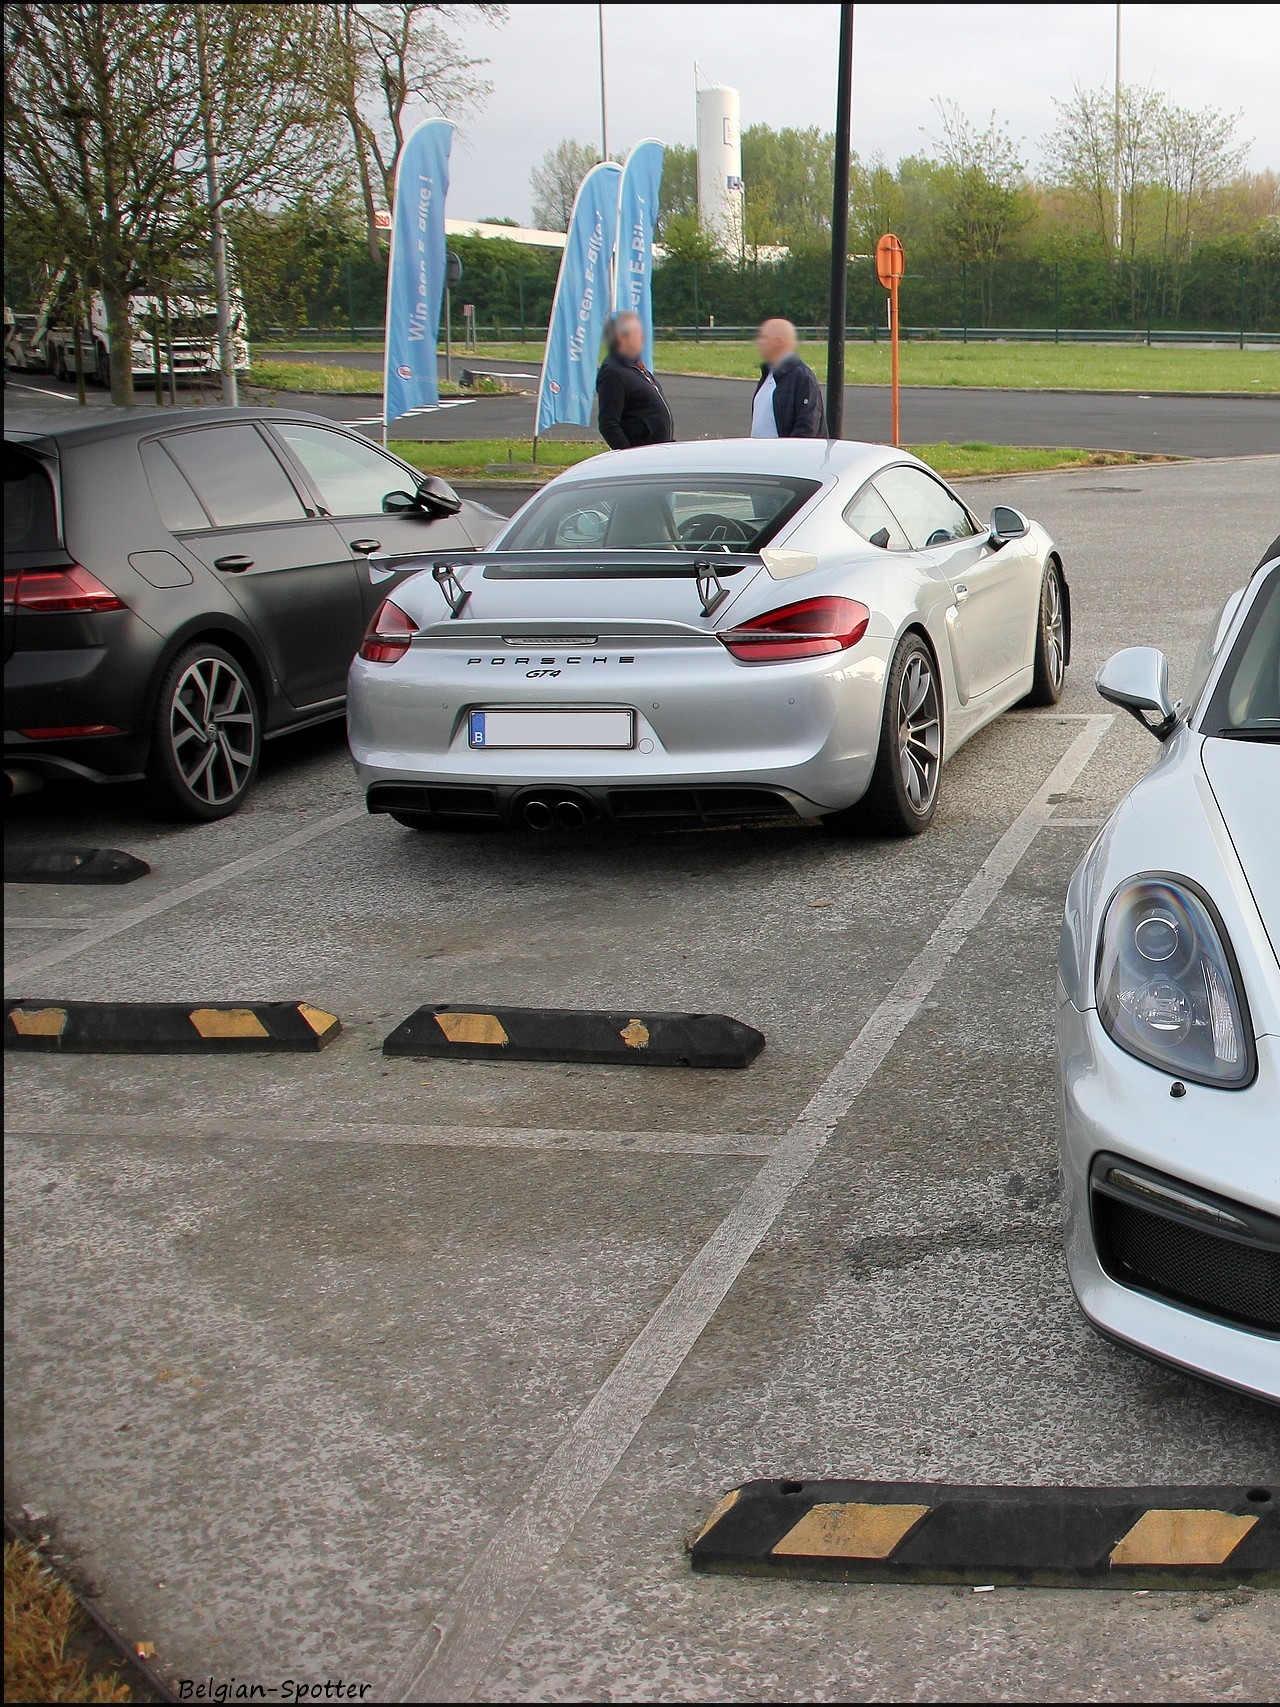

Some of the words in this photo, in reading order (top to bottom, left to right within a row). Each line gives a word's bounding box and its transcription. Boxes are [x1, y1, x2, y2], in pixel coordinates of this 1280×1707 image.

[577, 287, 594, 322] een
[407, 302, 427, 341] Win
[569, 325, 586, 362] Win
[467, 656, 635, 665] PORSCHE
[525, 669, 562, 678] GT4
[474, 731, 483, 743] B
